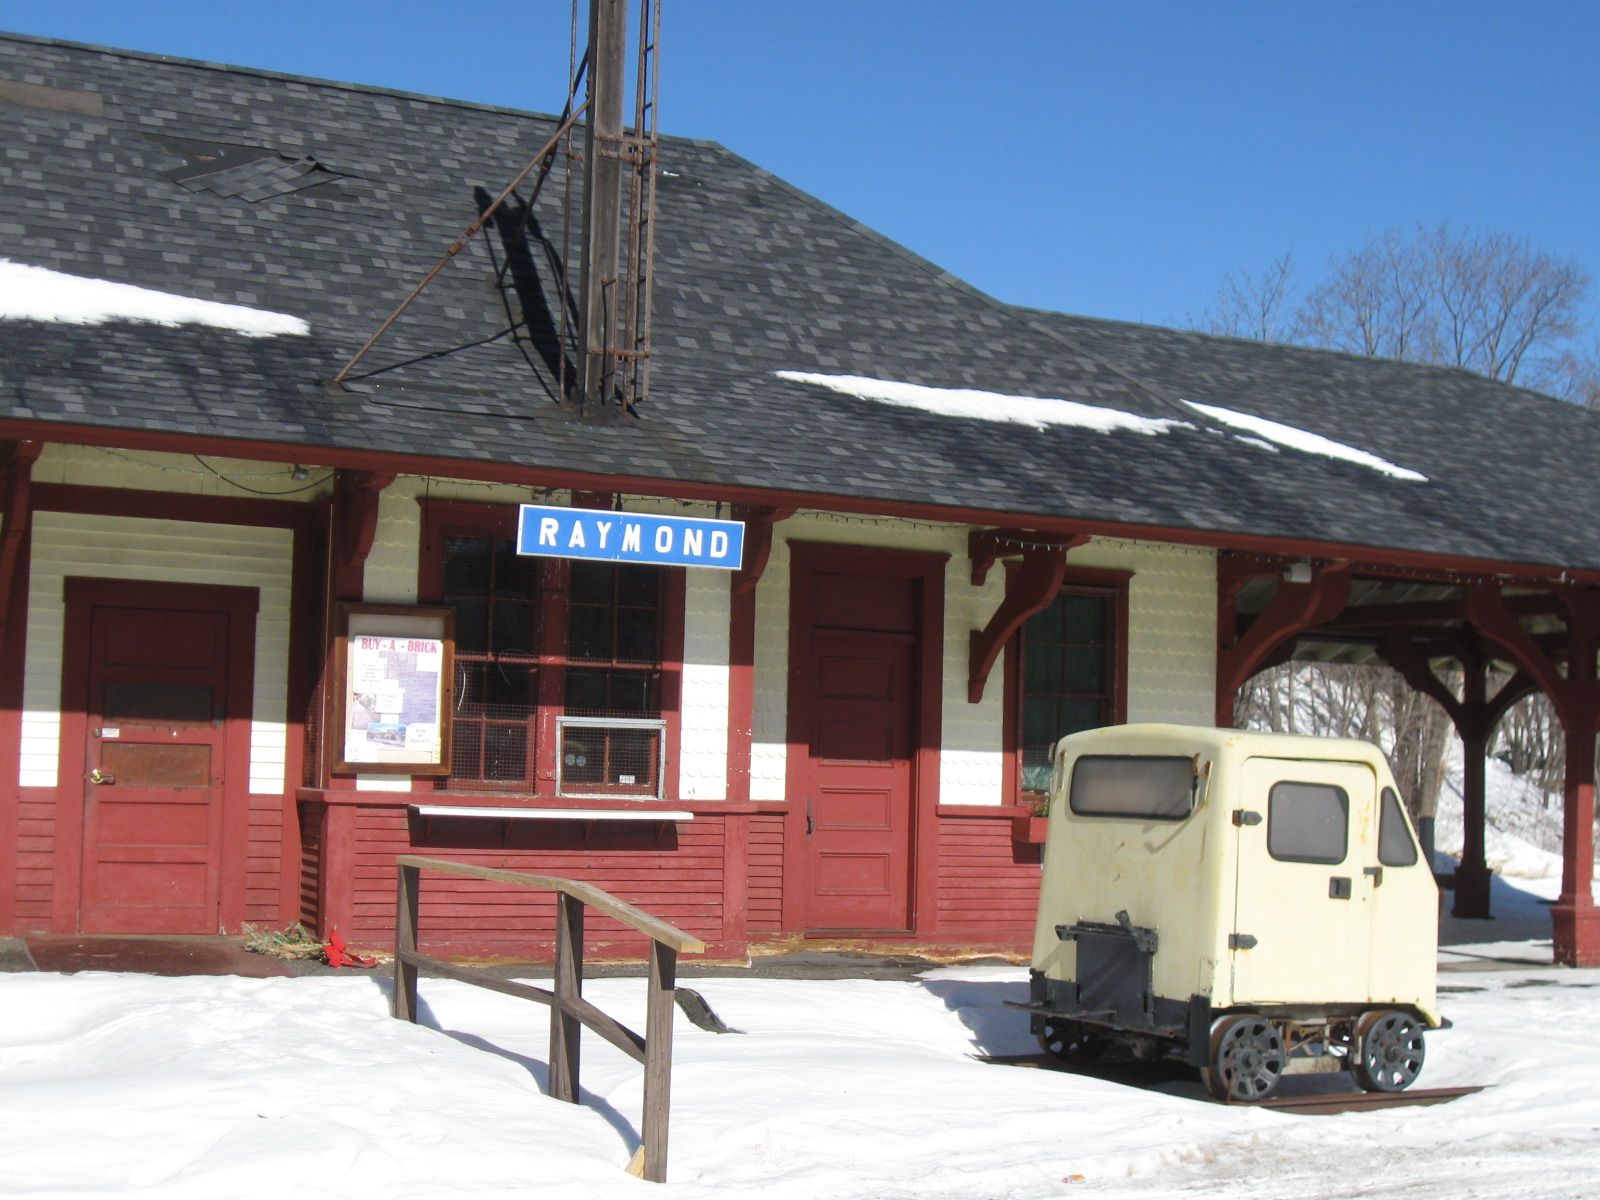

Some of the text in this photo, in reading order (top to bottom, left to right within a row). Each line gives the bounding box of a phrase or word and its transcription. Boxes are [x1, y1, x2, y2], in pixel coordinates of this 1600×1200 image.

[538, 517, 728, 558] RAYMOND
[361, 638, 380, 650] BUY
[407, 640, 437, 653] BRICK
